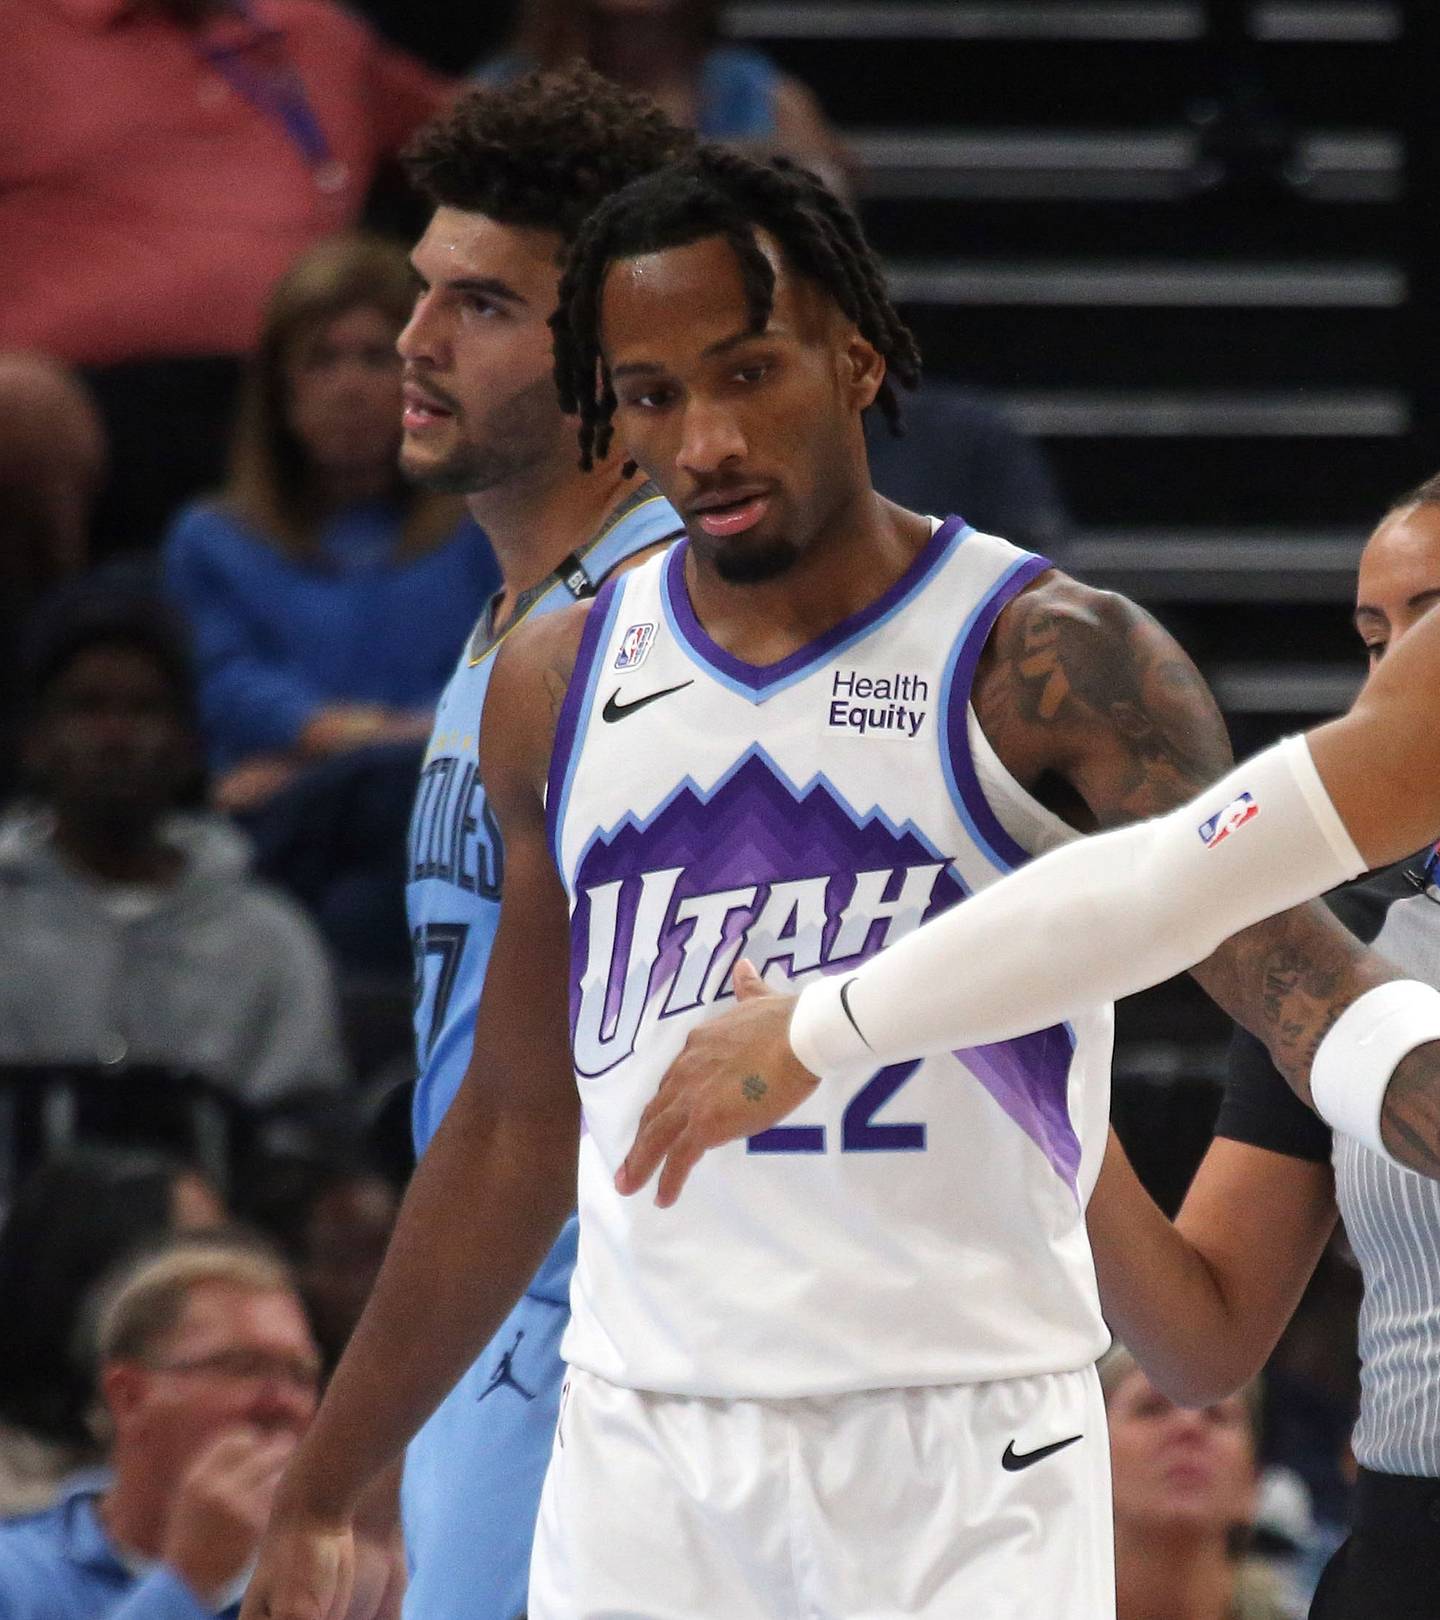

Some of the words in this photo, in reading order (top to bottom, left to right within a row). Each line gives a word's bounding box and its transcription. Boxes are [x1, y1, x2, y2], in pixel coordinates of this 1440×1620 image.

[832, 671, 927, 701] Health
[829, 700, 926, 737] Equity
[573, 858, 956, 1078] UTAH
